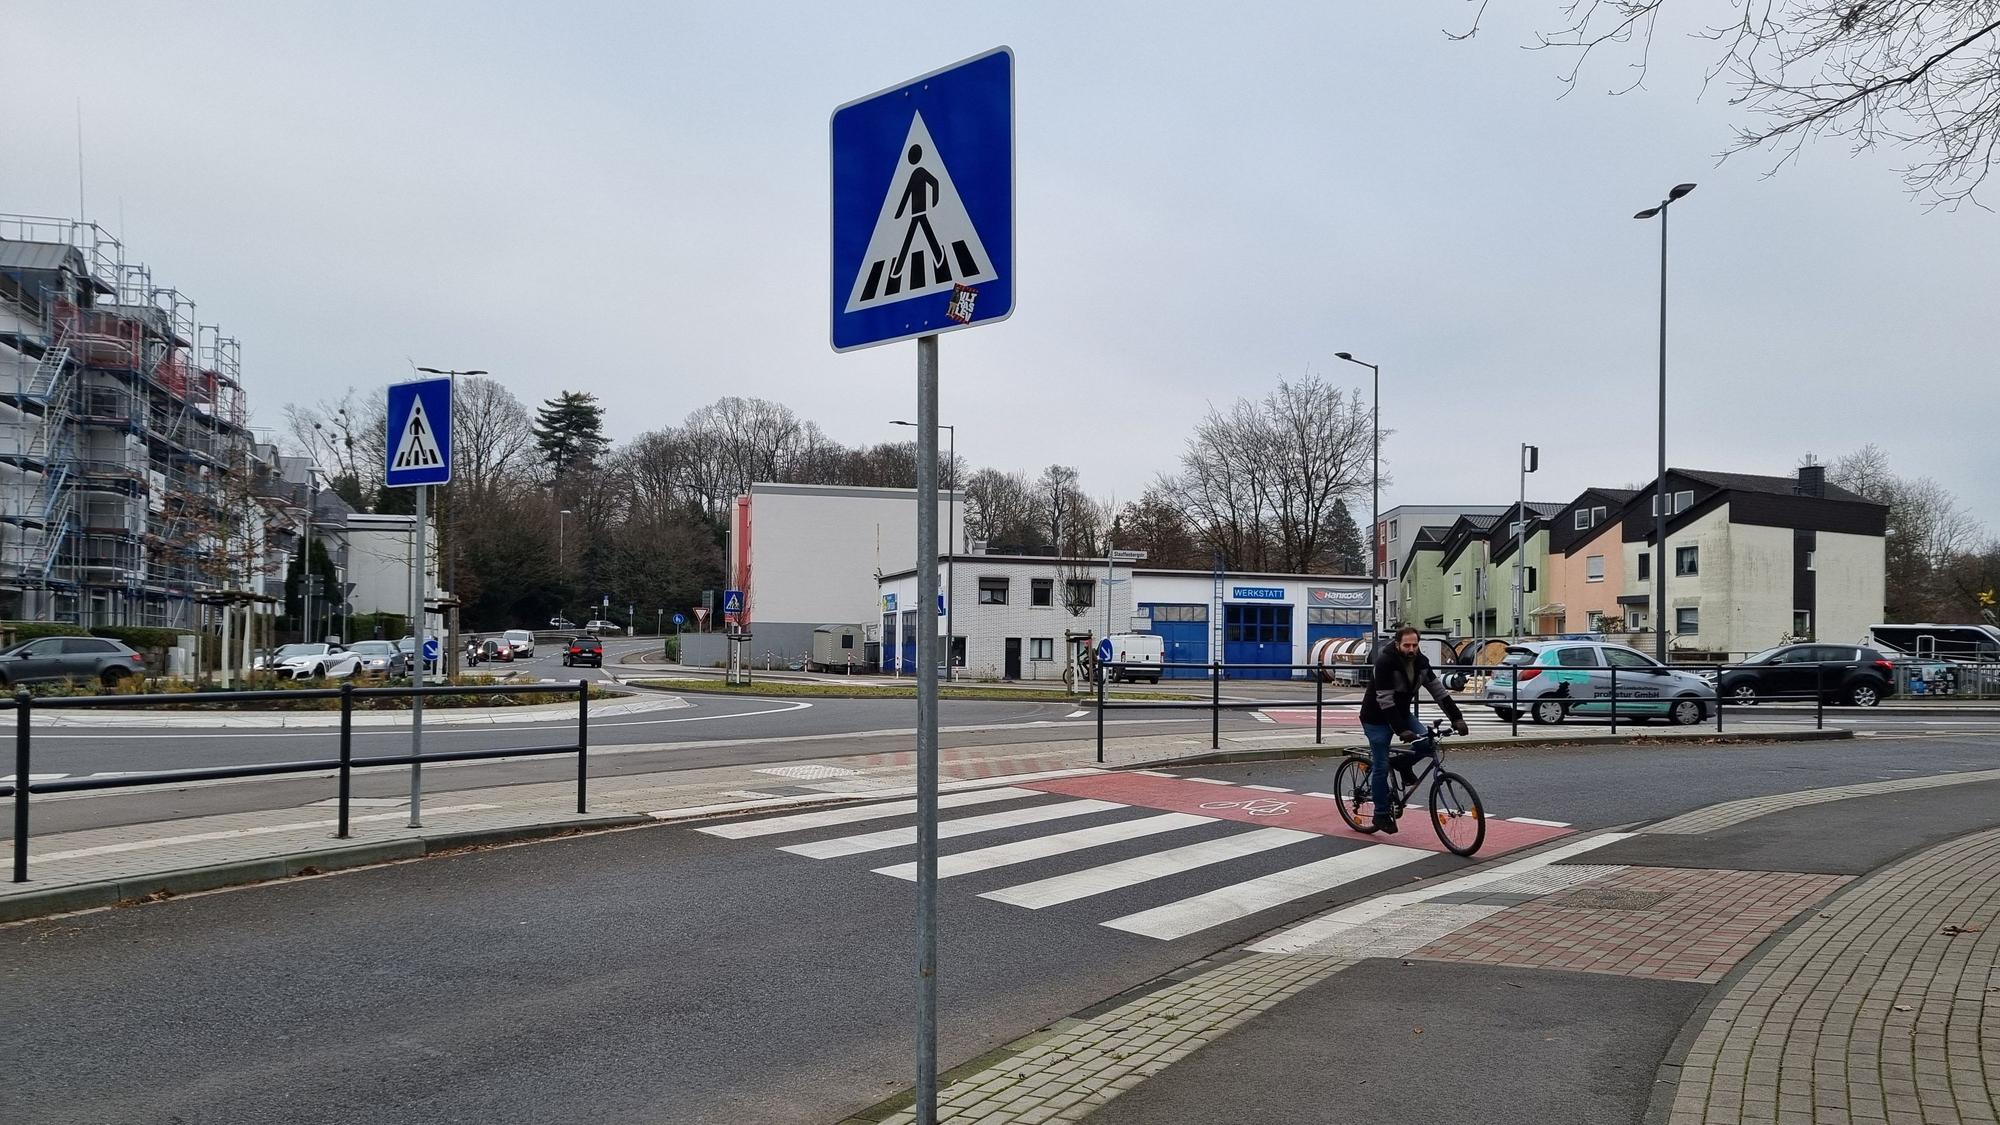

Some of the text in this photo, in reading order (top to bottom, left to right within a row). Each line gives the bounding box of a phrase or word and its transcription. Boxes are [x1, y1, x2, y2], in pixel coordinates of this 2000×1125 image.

[960, 291, 977, 303] ULT
[955, 306, 972, 321] LEV
[1234, 589, 1283, 598] WERKSTATT
